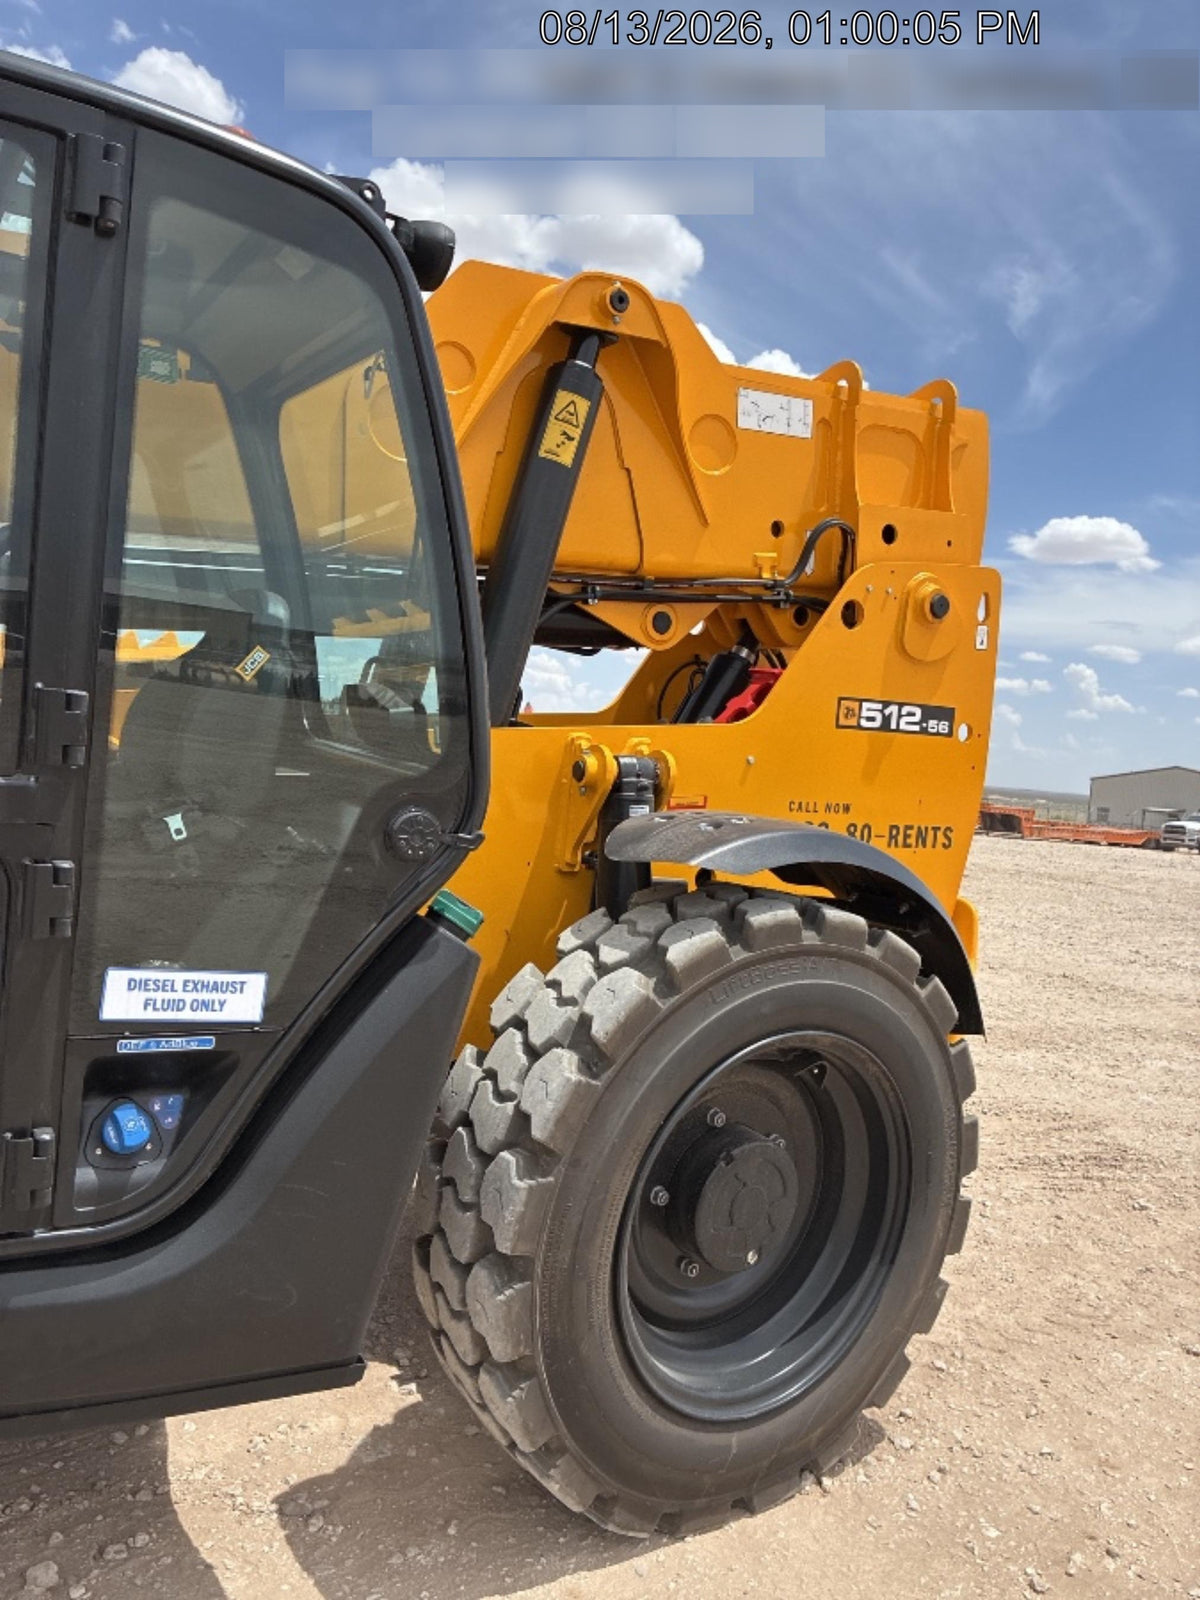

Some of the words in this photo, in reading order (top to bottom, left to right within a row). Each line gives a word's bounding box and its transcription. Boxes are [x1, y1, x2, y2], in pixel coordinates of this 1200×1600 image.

[244, 651, 265, 675] JCB
[788, 800, 819, 813] CALL
[824, 802, 852, 815] NOW
[127, 977, 179, 993] DIESEL
[182, 979, 247, 994] EXHAUST
[143, 998, 187, 1013] FLUID
[189, 998, 227, 1013] ONLY
